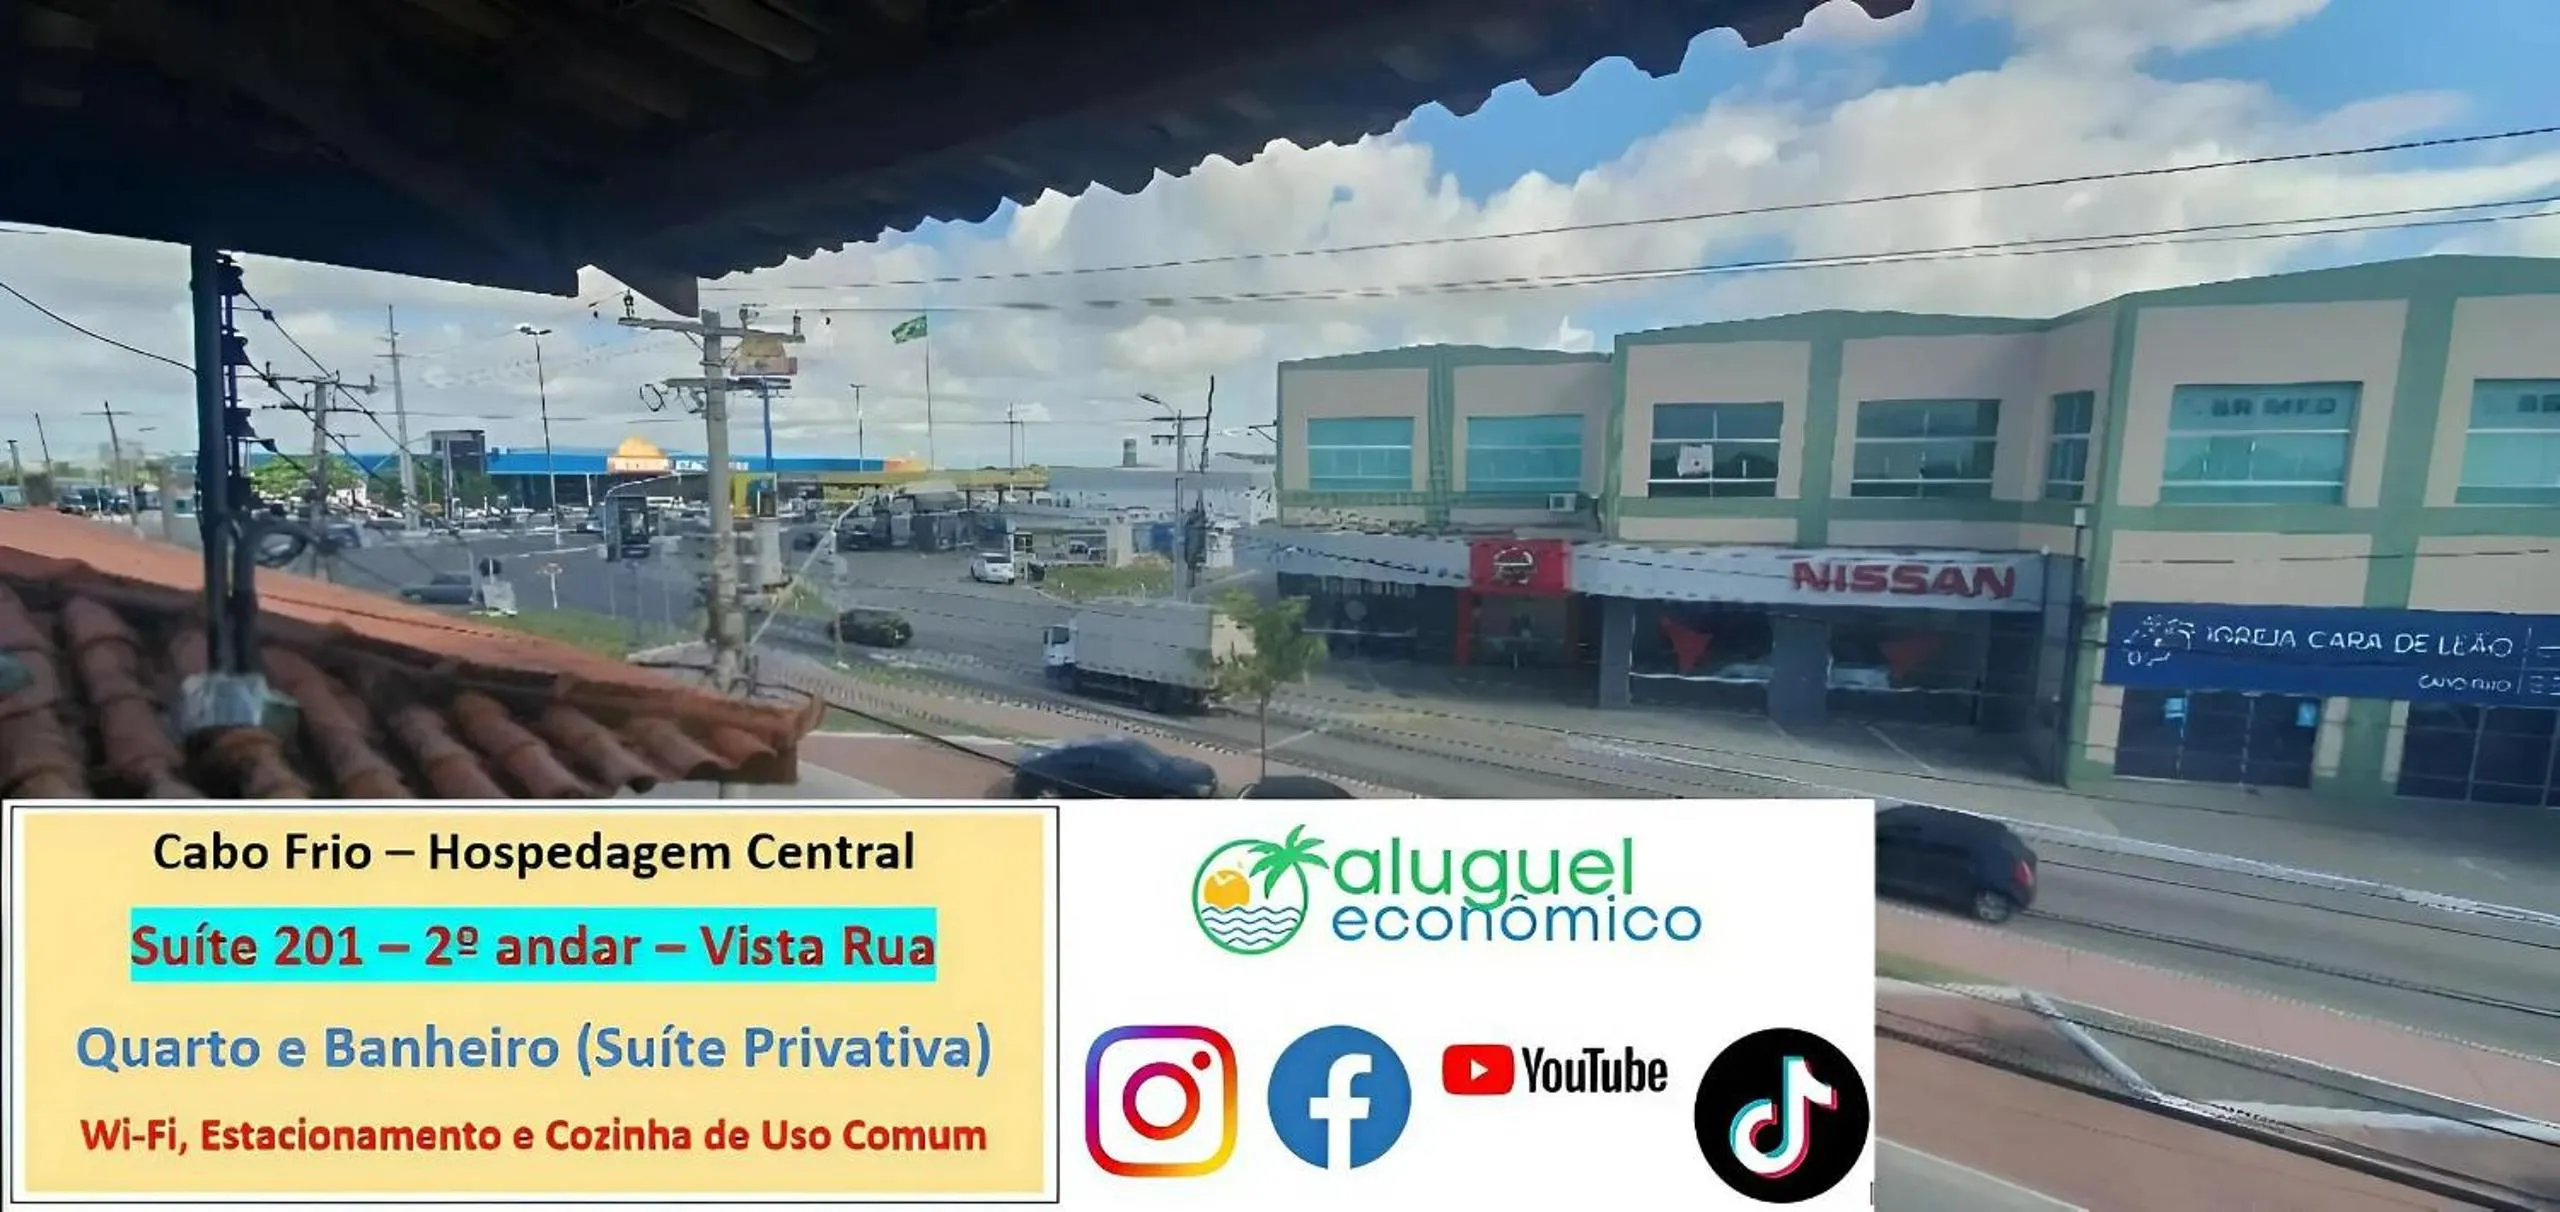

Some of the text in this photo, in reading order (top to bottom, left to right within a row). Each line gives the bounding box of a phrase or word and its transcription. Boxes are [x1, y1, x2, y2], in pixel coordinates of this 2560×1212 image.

[1791, 560, 2016, 600] NISSAN
[2307, 630, 2384, 650] CARA
[2394, 633, 2431, 653] DE
